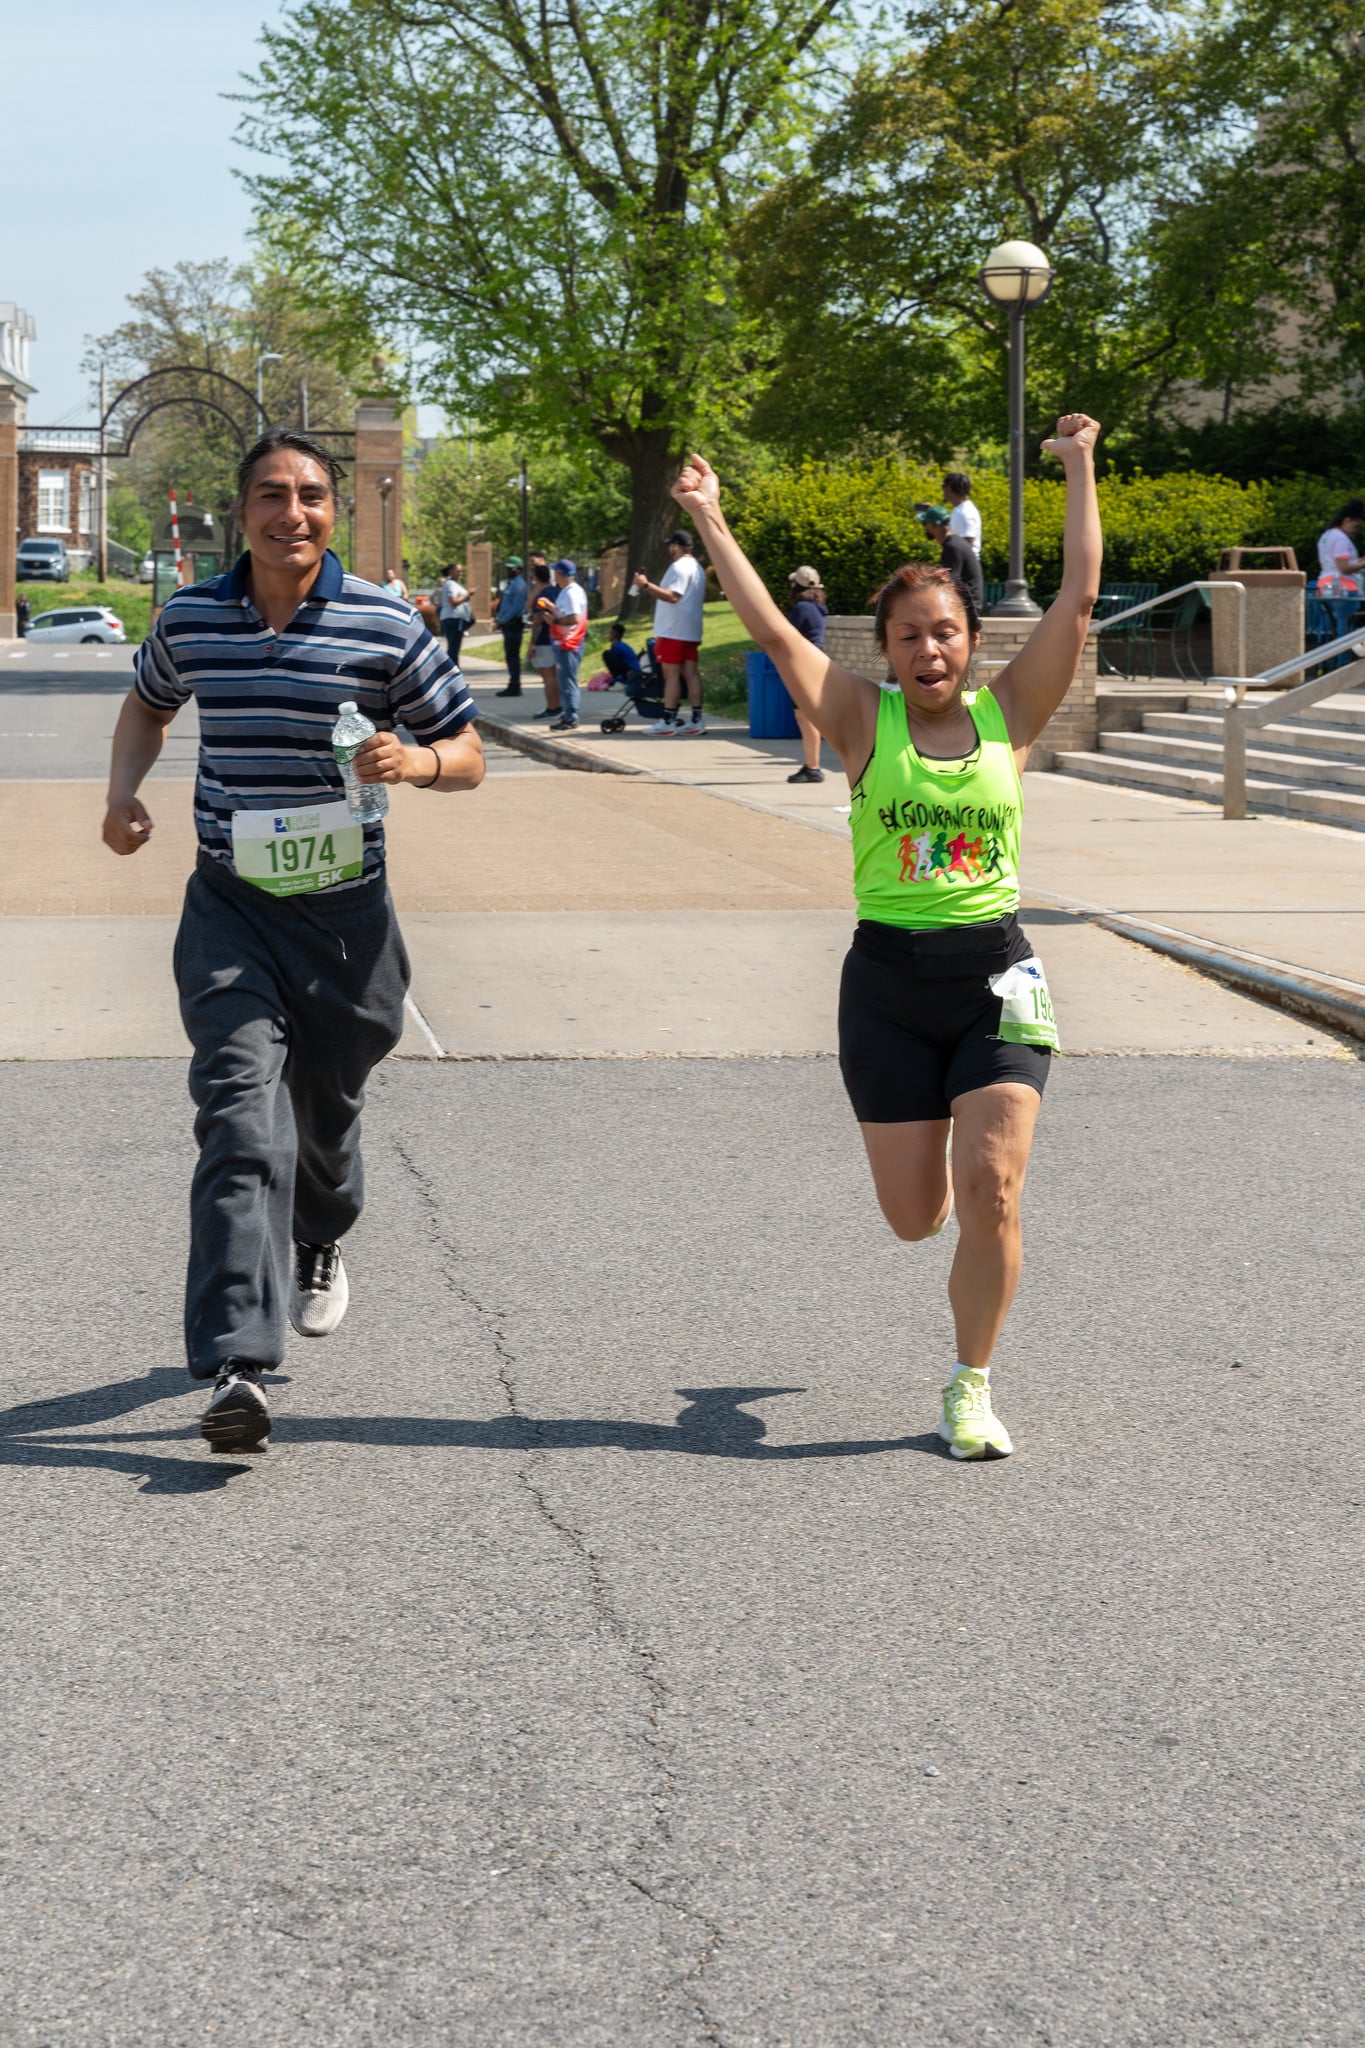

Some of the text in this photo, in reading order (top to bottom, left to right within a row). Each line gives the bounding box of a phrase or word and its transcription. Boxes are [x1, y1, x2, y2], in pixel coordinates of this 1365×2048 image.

[901, 799, 975, 832] ENDURANCE
[264, 834, 336, 873] 1974
[318, 868, 344, 887] 5K
